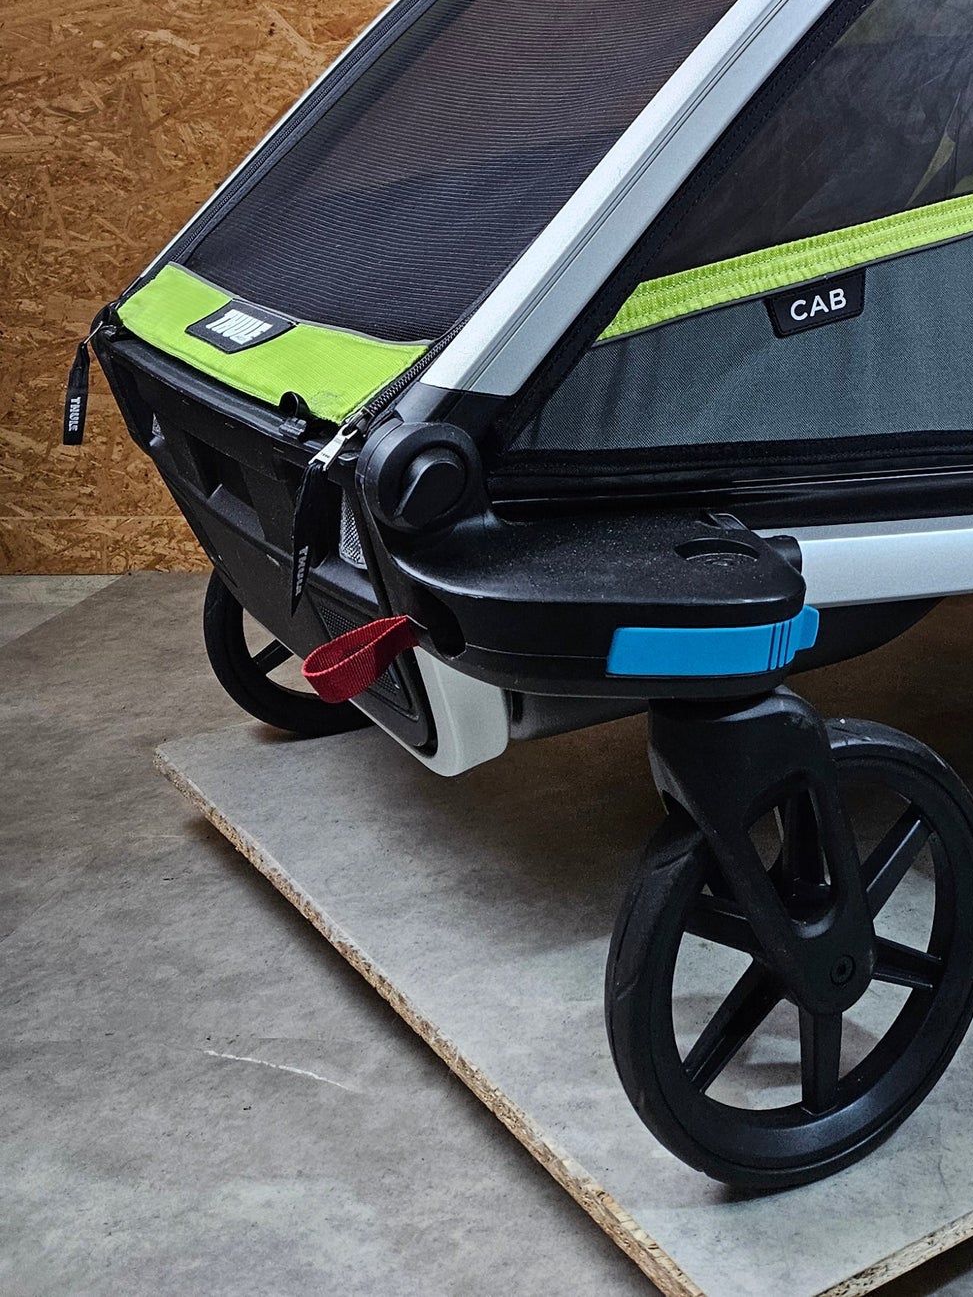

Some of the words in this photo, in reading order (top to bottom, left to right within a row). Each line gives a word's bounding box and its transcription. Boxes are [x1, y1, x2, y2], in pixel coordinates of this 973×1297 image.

[790, 288, 847, 321] CAB
[205, 308, 274, 345] THULE
[68, 396, 82, 432] THULE
